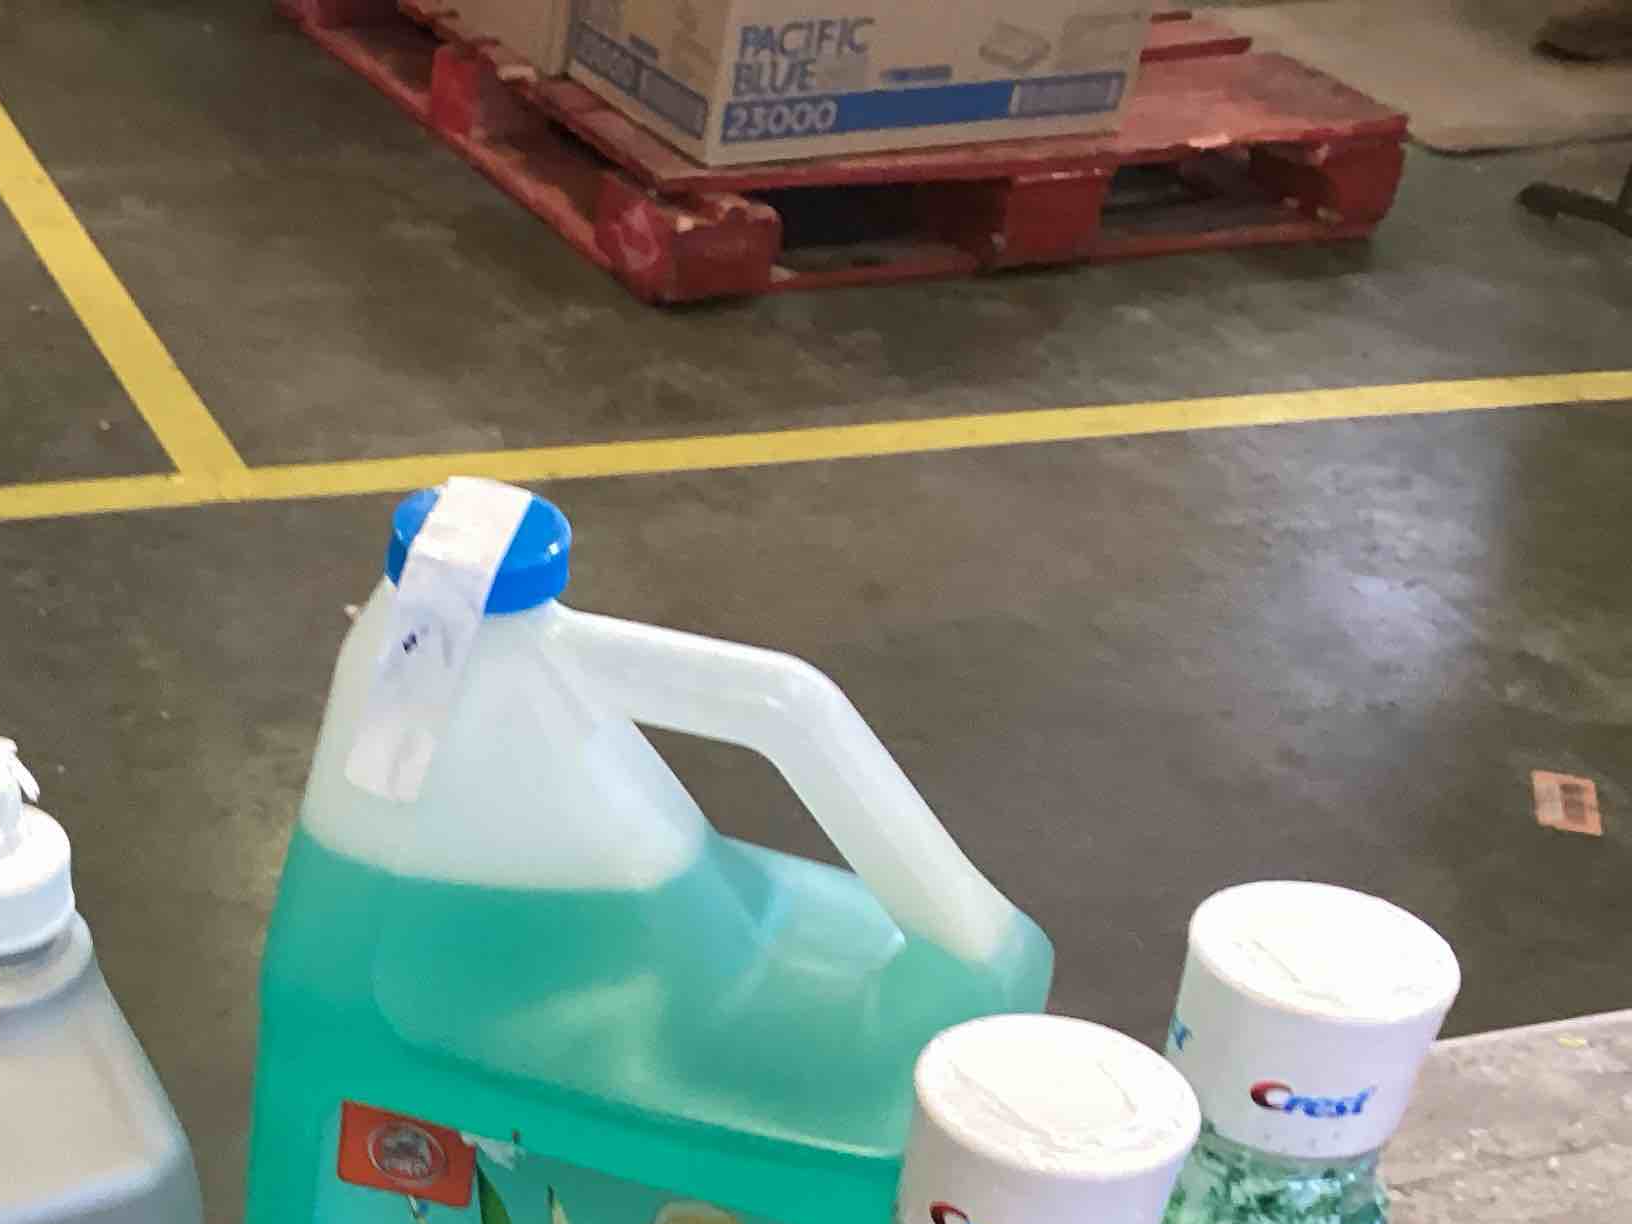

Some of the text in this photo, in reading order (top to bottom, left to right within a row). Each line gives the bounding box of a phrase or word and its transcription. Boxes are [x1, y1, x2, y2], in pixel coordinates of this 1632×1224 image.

[739, 18, 874, 54] PACIFIC
[734, 58, 816, 95] BLUE
[725, 101, 837, 138] 23000
[1249, 1079, 1371, 1118] Crest
